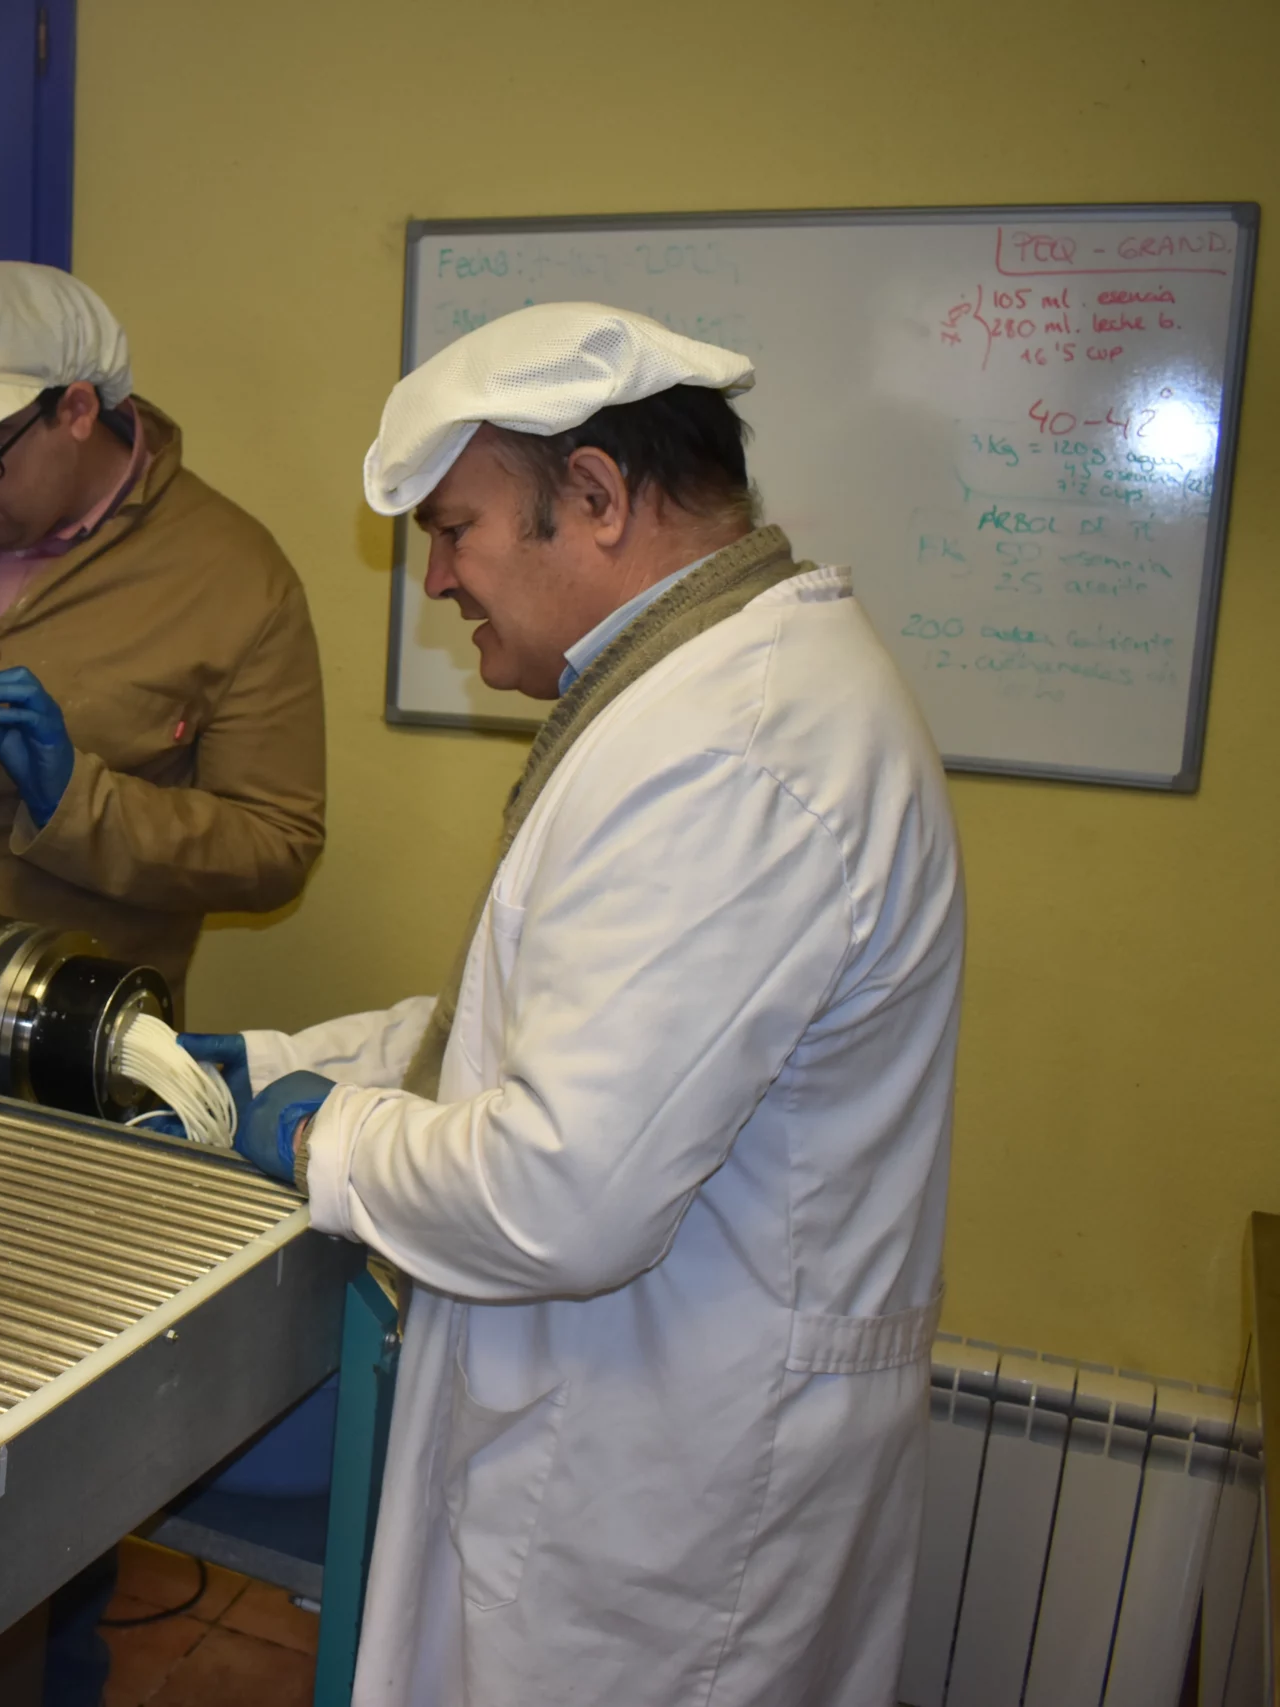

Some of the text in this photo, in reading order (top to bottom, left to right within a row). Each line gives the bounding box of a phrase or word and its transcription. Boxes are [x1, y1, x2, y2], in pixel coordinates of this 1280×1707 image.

[992, 287, 1033, 310] 105
[990, 317, 1037, 340] 280
[901, 612, 965, 640] 200
